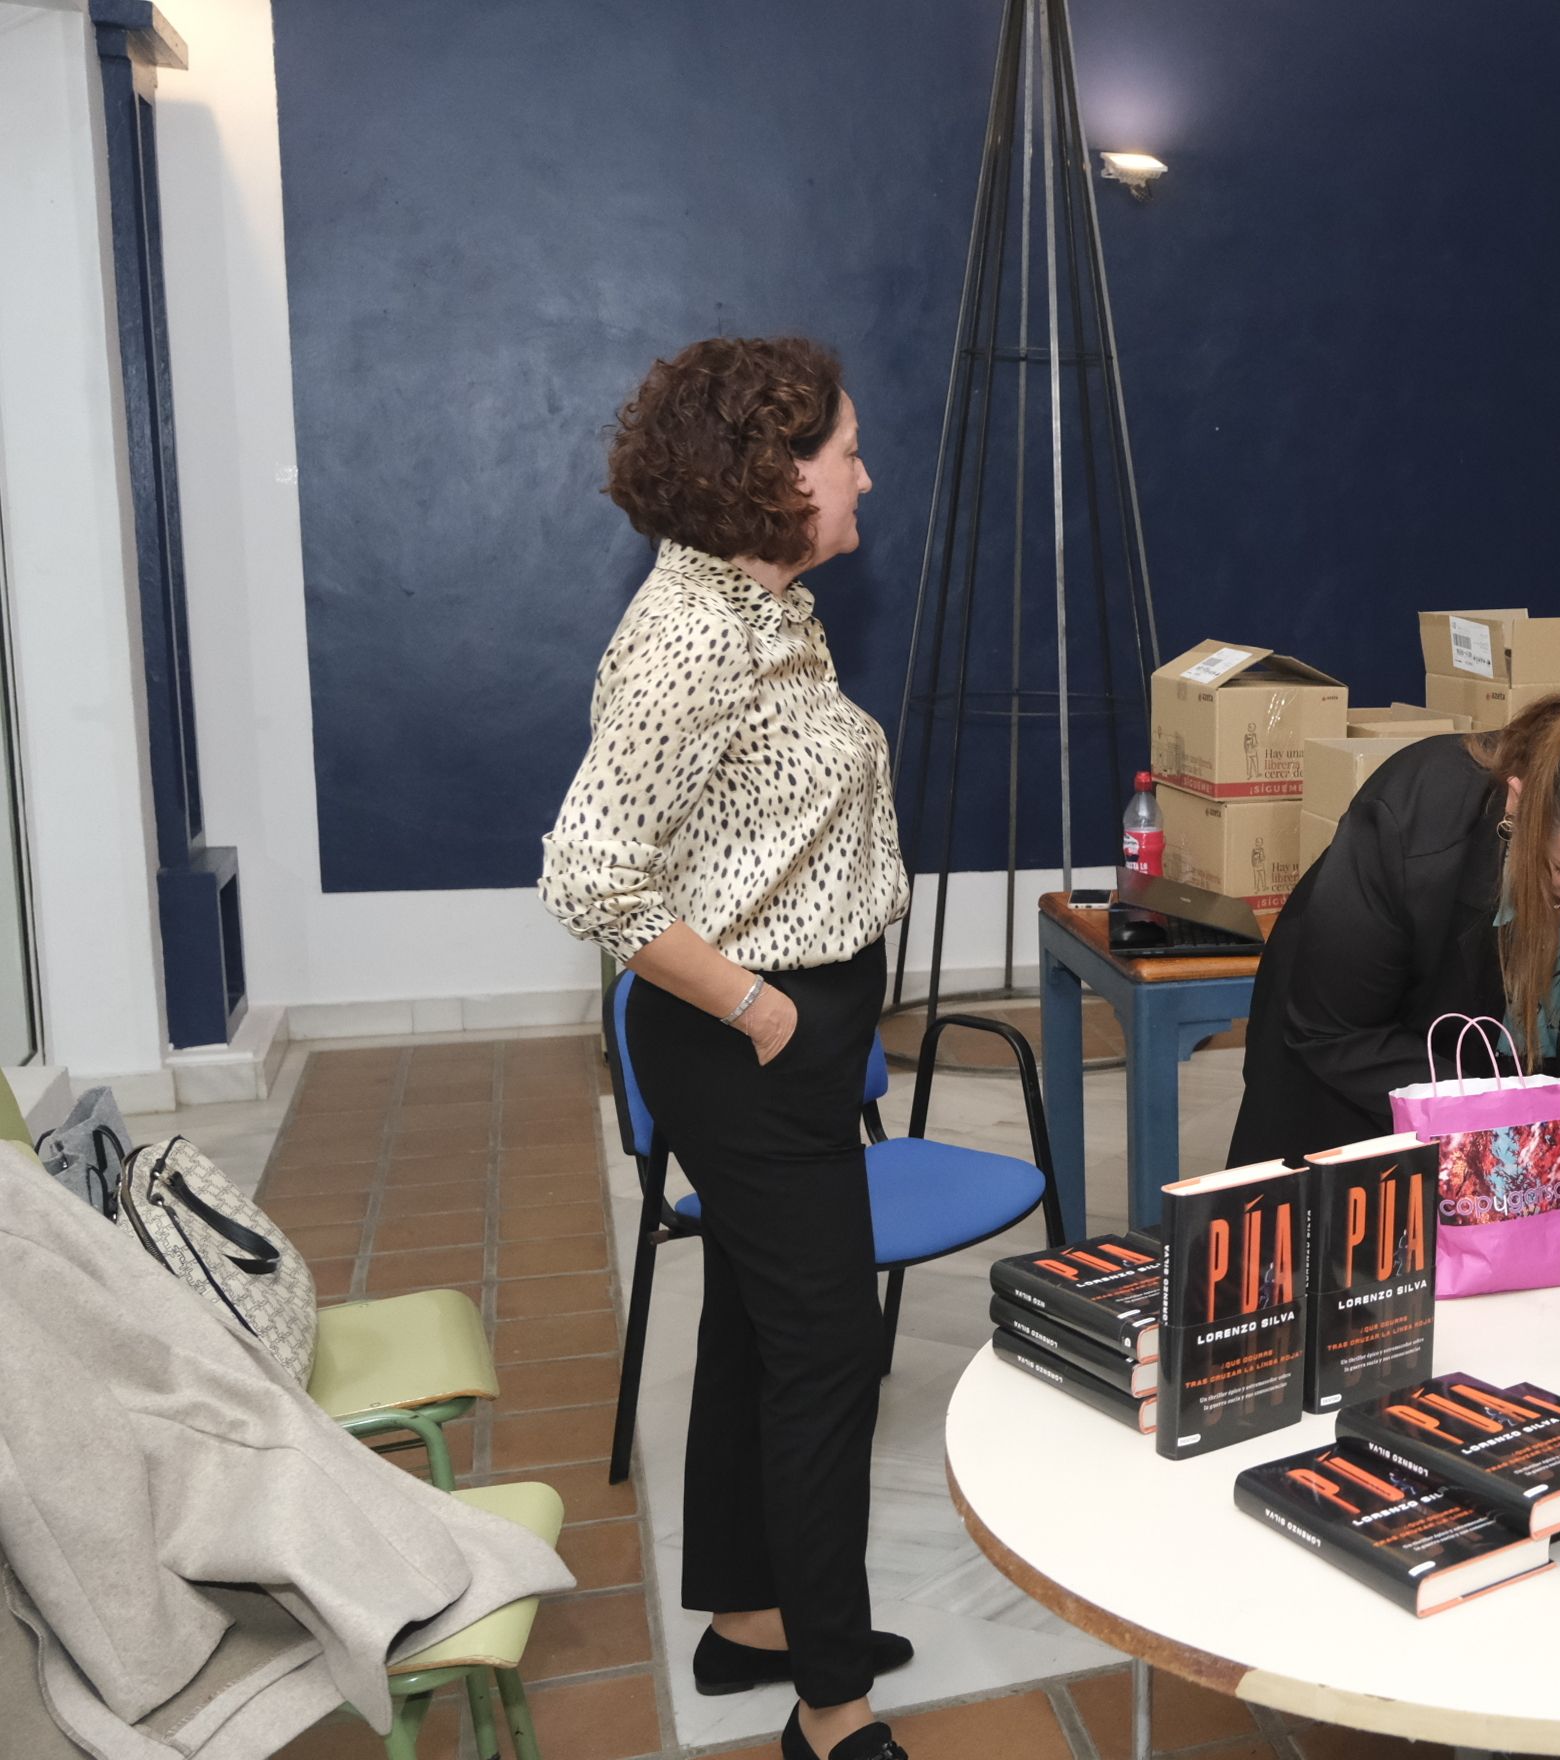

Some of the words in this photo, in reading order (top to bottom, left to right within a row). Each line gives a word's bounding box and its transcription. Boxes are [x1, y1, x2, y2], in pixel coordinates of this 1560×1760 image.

[1265, 748, 1284, 759] Hay
[1346, 1163, 1425, 1288] PÚA
[1033, 1243, 1155, 1281] PÚA
[1207, 1194, 1293, 1323] PÚA
[1076, 1270, 1135, 1288] LORENZO
[1138, 1262, 1160, 1272] SIL
[1015, 1289, 1032, 1302] SILVA
[1162, 1278, 1170, 1326] ORENZO
[1338, 1289, 1393, 1310] LORENZO
[1397, 1280, 1427, 1295] SILVA
[1013, 1320, 1030, 1334] SILVA
[1031, 1330, 1058, 1349] LORENZO
[1197, 1321, 1257, 1345] LORENZO
[1261, 1311, 1295, 1329] SILVA
[1017, 1355, 1034, 1369] SILVA
[1035, 1364, 1063, 1383] LORENZO
[1385, 1384, 1541, 1445] PÚA
[1461, 1431, 1521, 1455] LORENZO
[1523, 1417, 1560, 1433] SILVA
[1368, 1442, 1391, 1459] SILVA
[1392, 1453, 1429, 1477] LORENZO
[1285, 1450, 1405, 1515] PÚ
[1264, 1508, 1287, 1526] SILVA
[1352, 1499, 1418, 1526] LORENZO
[1420, 1488, 1446, 1504] SIL
[1287, 1521, 1321, 1548] LORENZO
